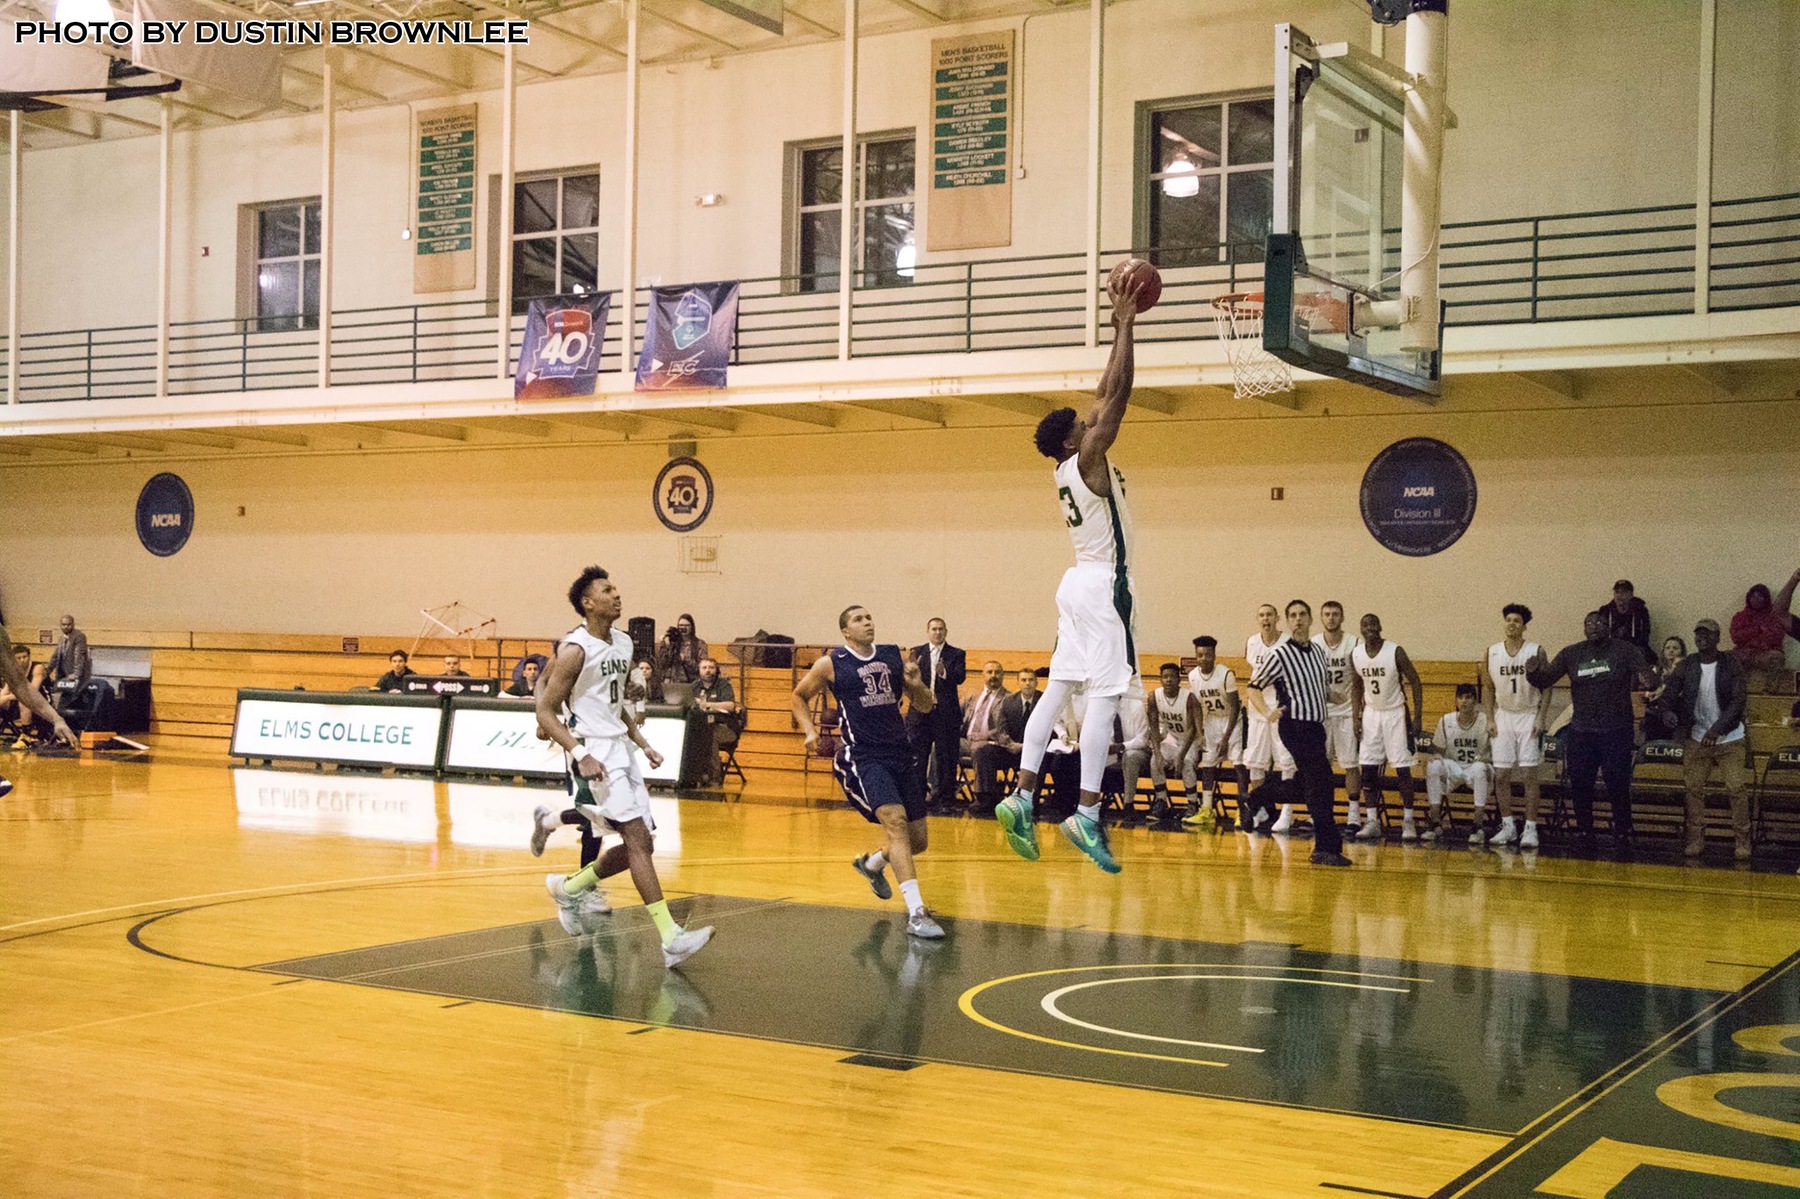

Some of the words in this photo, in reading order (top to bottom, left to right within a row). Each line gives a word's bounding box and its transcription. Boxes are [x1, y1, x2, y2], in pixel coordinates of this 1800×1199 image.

[962, 43, 1006, 55] BASKETBALL
[976, 51, 1008, 61] SCORERS
[540, 331, 588, 365] 40
[669, 486, 695, 506] 40
[1403, 486, 1435, 497] NCAA
[1059, 485, 1083, 528] 3
[1394, 508, 1431, 518] Division
[151, 513, 181, 528] NCAA
[601, 659, 628, 677] ELMS
[1326, 658, 1346, 667] LMS
[1362, 667, 1386, 677] ELMS
[1500, 665, 1525, 676] ELMS
[862, 673, 893, 694] 34
[1370, 680, 1380, 695] 3
[1510, 678, 1517, 694] 1
[610, 679, 619, 704] 0
[1200, 688, 1221, 698] ELMS
[1204, 699, 1225, 712] 24
[260, 718, 312, 739] ELMS
[318, 721, 414, 745] COLLEGE
[1454, 738, 1478, 748] ELMS
[1457, 749, 1475, 762] 25
[1645, 747, 1684, 758] ELMS
